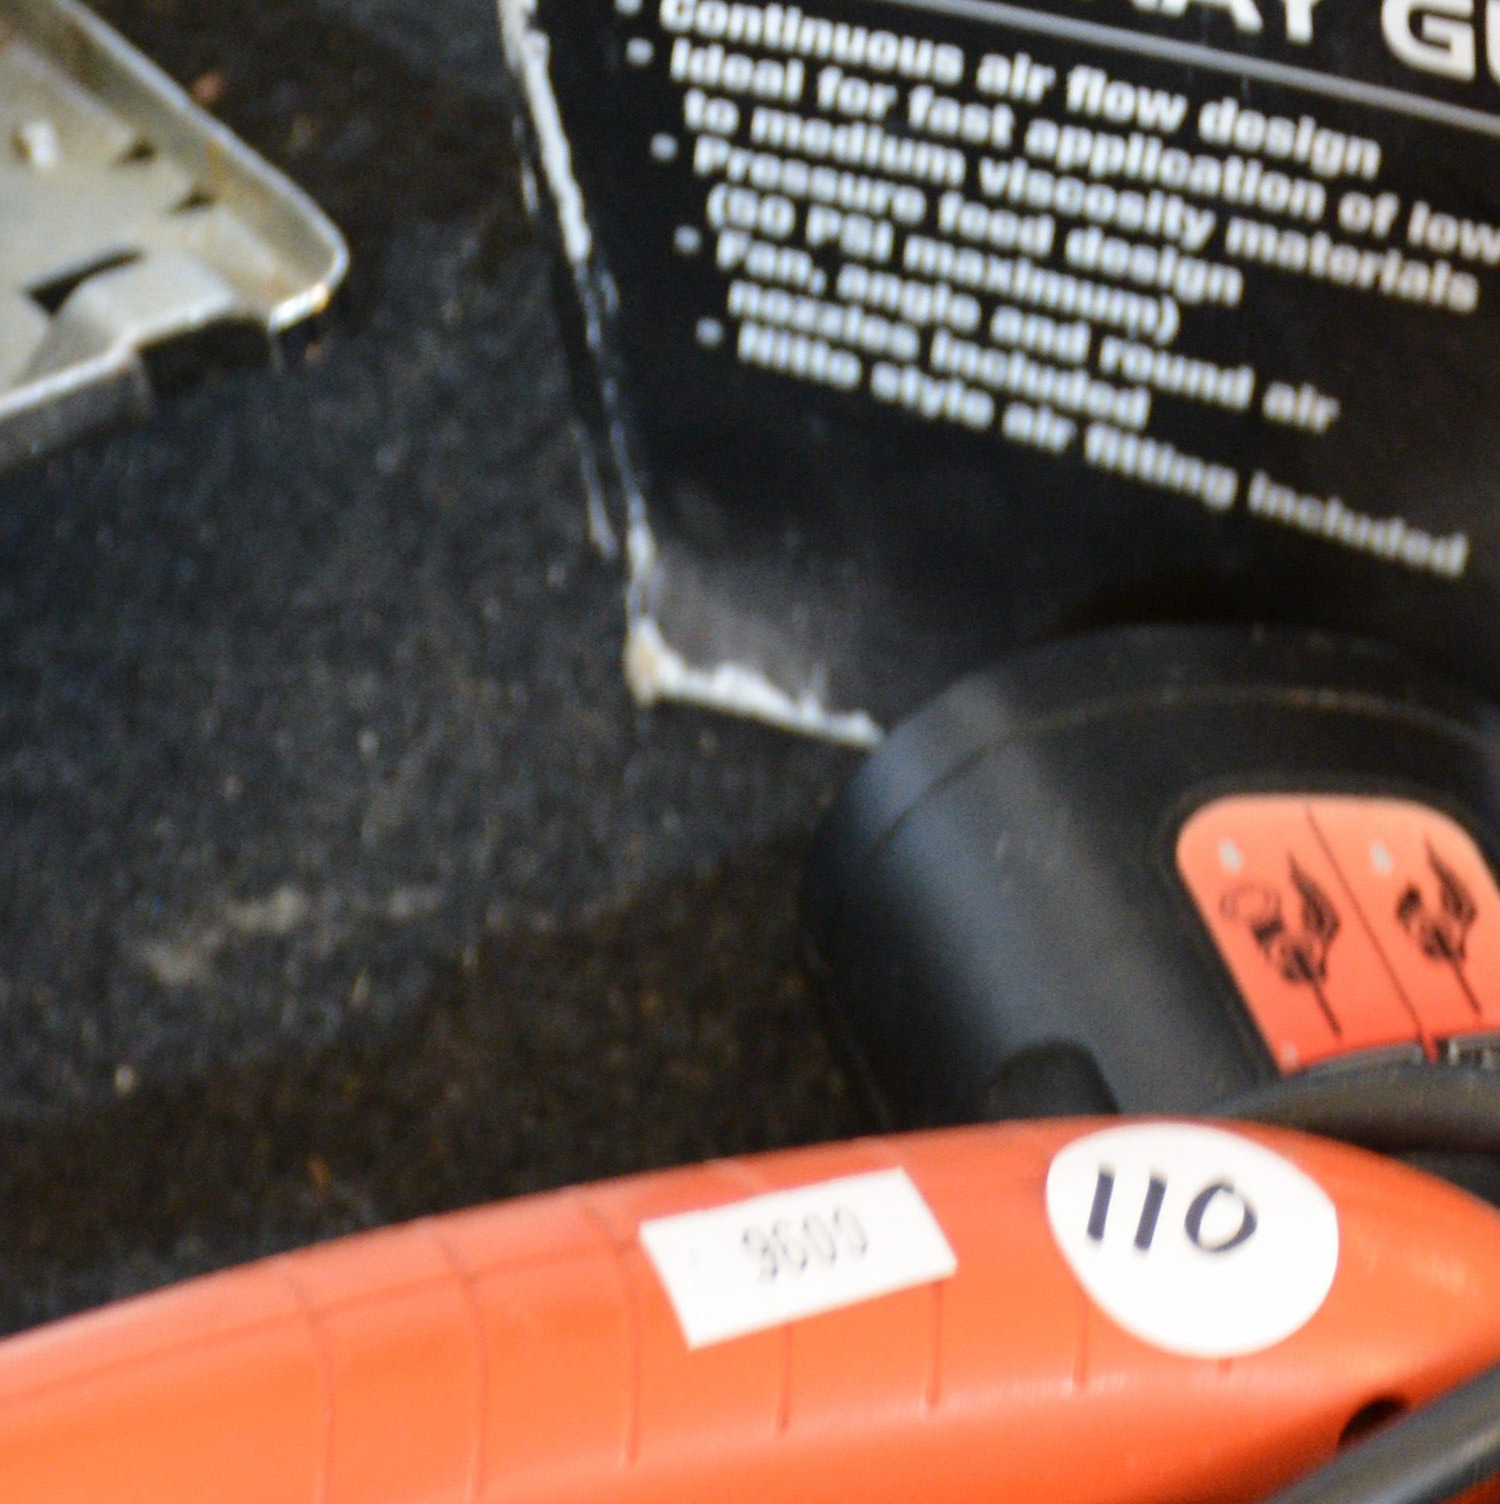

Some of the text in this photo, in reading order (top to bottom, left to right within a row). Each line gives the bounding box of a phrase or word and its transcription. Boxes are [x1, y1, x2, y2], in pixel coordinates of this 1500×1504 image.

[659, 0, 1382, 180] Continuous air flow design
[670, 37, 805, 102] Ideal
[817, 66, 897, 119] for
[908, 84, 1014, 150] fast
[1024, 117, 1327, 222] application
[1338, 191, 1398, 238] of
[683, 88, 1480, 315] to medium viscosity materials
[693, 134, 1244, 308] Pressure feed design
[806, 203, 894, 264] PSI
[903, 233, 1180, 346] maximum)
[716, 226, 1341, 434] Fan, angle and round air
[728, 278, 1151, 431] nozzles included
[870, 361, 994, 431] style
[1002, 401, 1078, 456] air
[1084, 422, 1238, 512] fitting
[1248, 469, 1469, 579] included
[1087, 1164, 1258, 1256] 110
